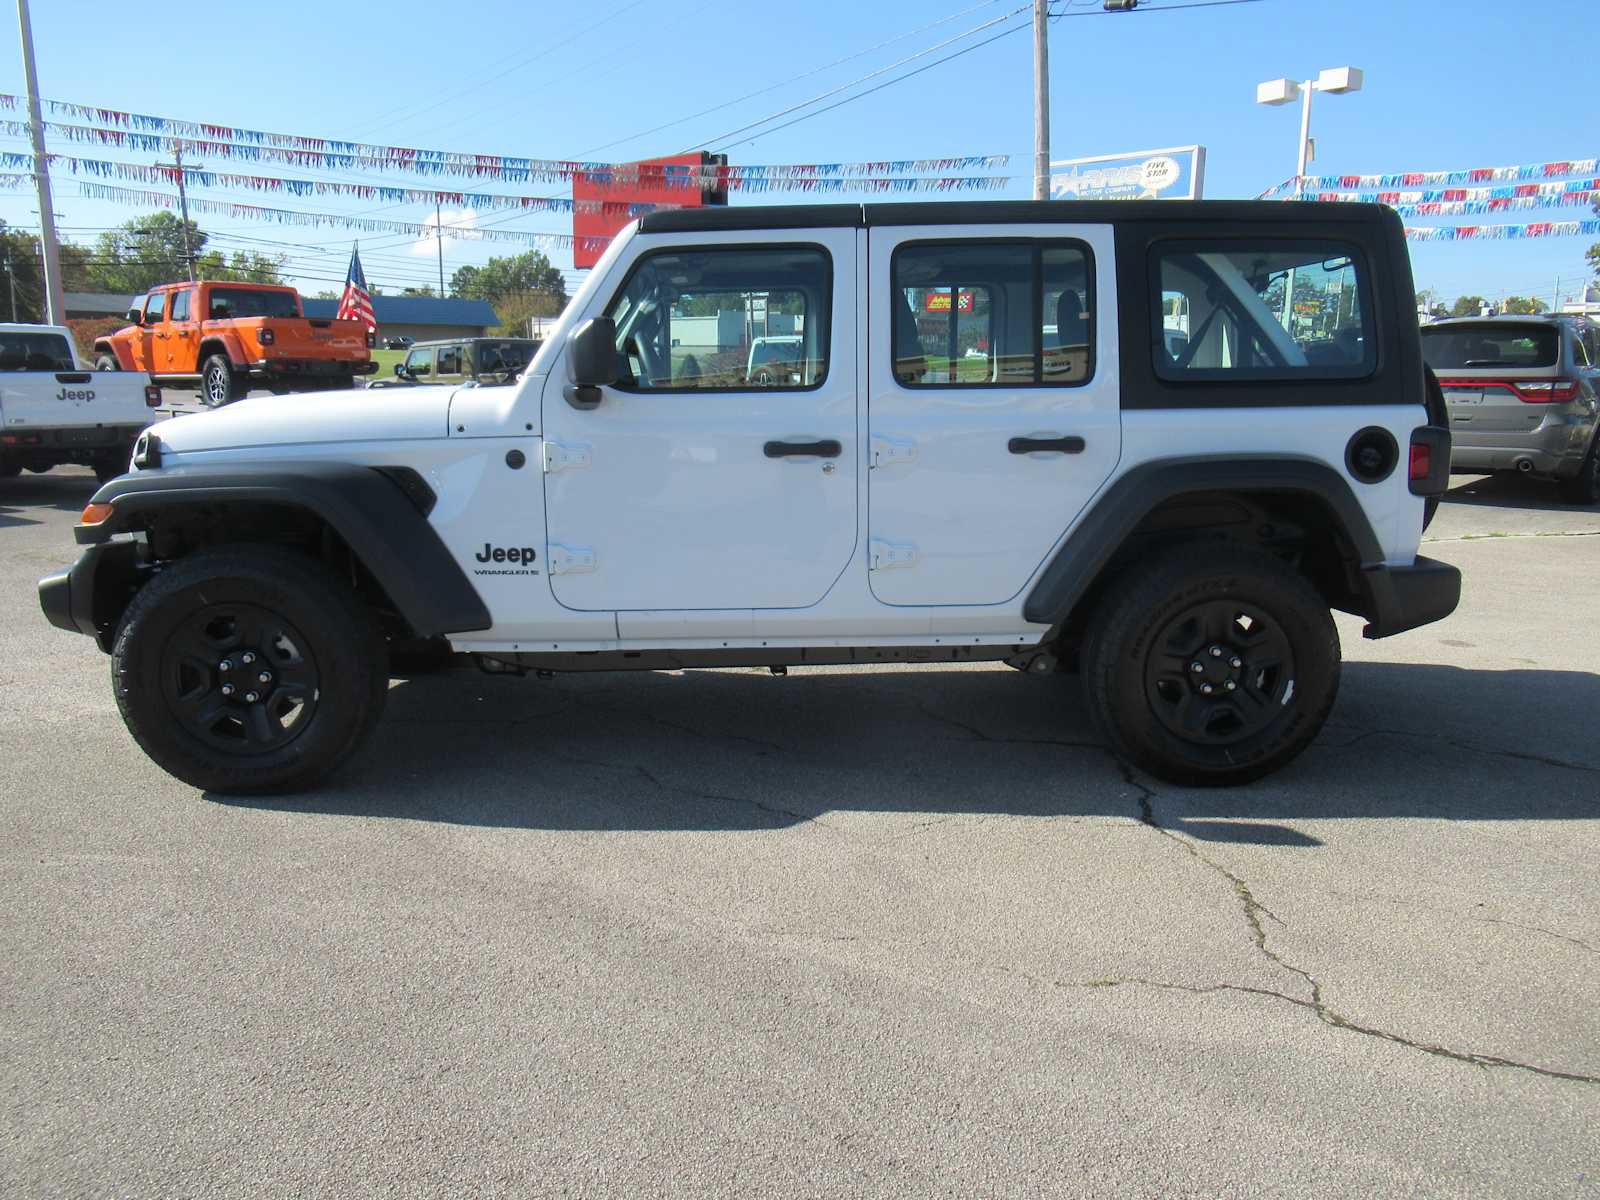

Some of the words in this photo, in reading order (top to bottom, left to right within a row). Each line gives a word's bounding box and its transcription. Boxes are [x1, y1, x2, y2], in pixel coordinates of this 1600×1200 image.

[1146, 169, 1168, 177] STAR
[56, 388, 95, 402] Jeep
[475, 543, 536, 566] Jeep
